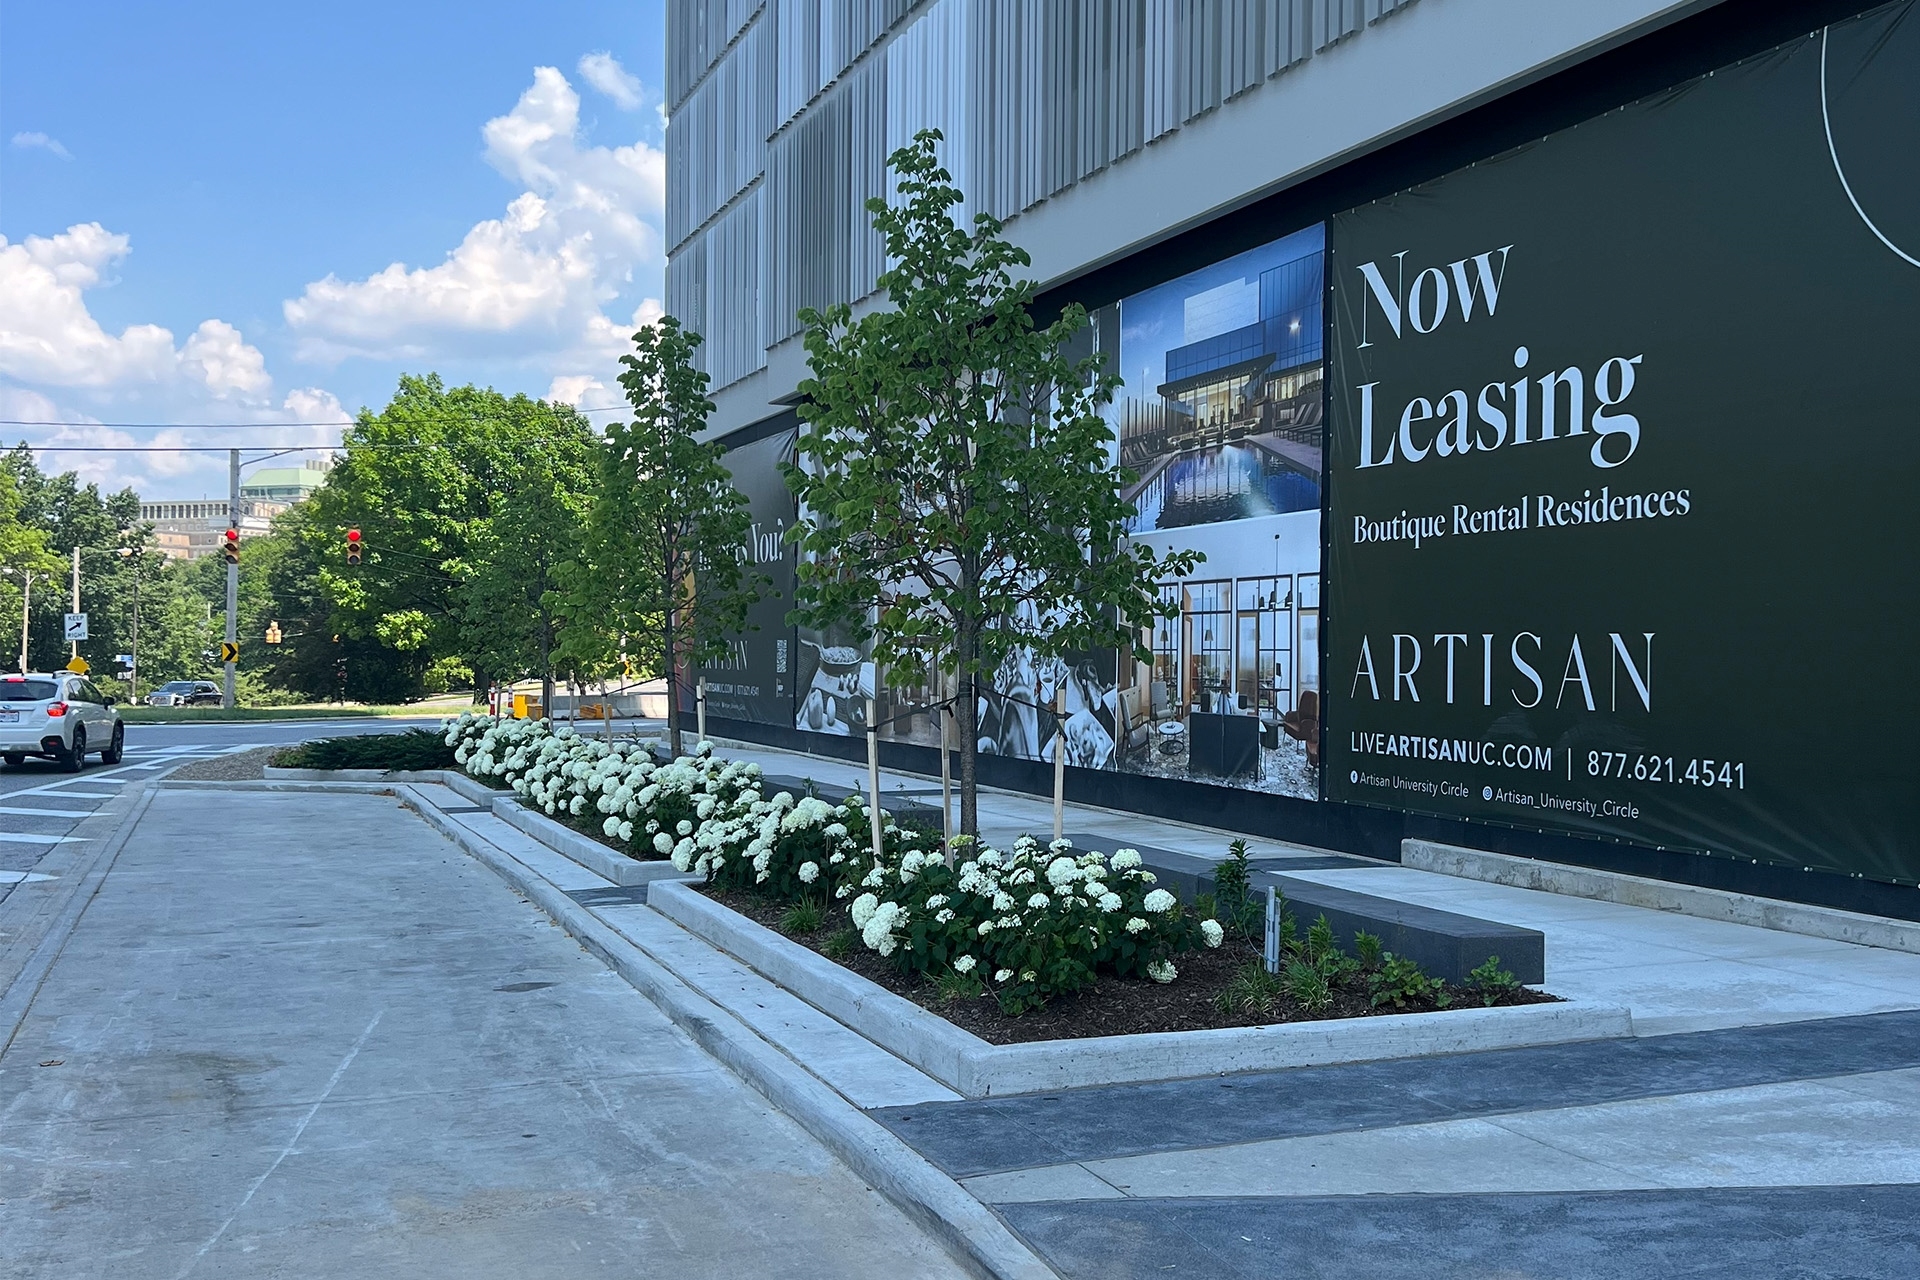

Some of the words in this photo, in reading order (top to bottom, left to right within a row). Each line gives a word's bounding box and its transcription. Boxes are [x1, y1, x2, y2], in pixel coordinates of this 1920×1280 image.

[1356, 245, 1514, 349] Now
[1355, 346, 1643, 469] Leasing
[751, 518, 785, 563] You?
[1354, 511, 1446, 549] Boutique
[1453, 496, 1528, 535] Rental
[1537, 487, 1691, 527] Residences
[700, 640, 748, 671] RSAN
[1350, 631, 1656, 713] ARTISAN
[1350, 731, 1552, 771] LIVEARTISANUC.COM
[1587, 751, 1744, 789] 877.621.4541
[1359, 771, 1390, 787] Artisan
[1392, 776, 1438, 797] University
[1440, 781, 1469, 798] Circle
[1494, 788, 1640, 819] Artisan_University_Circle
